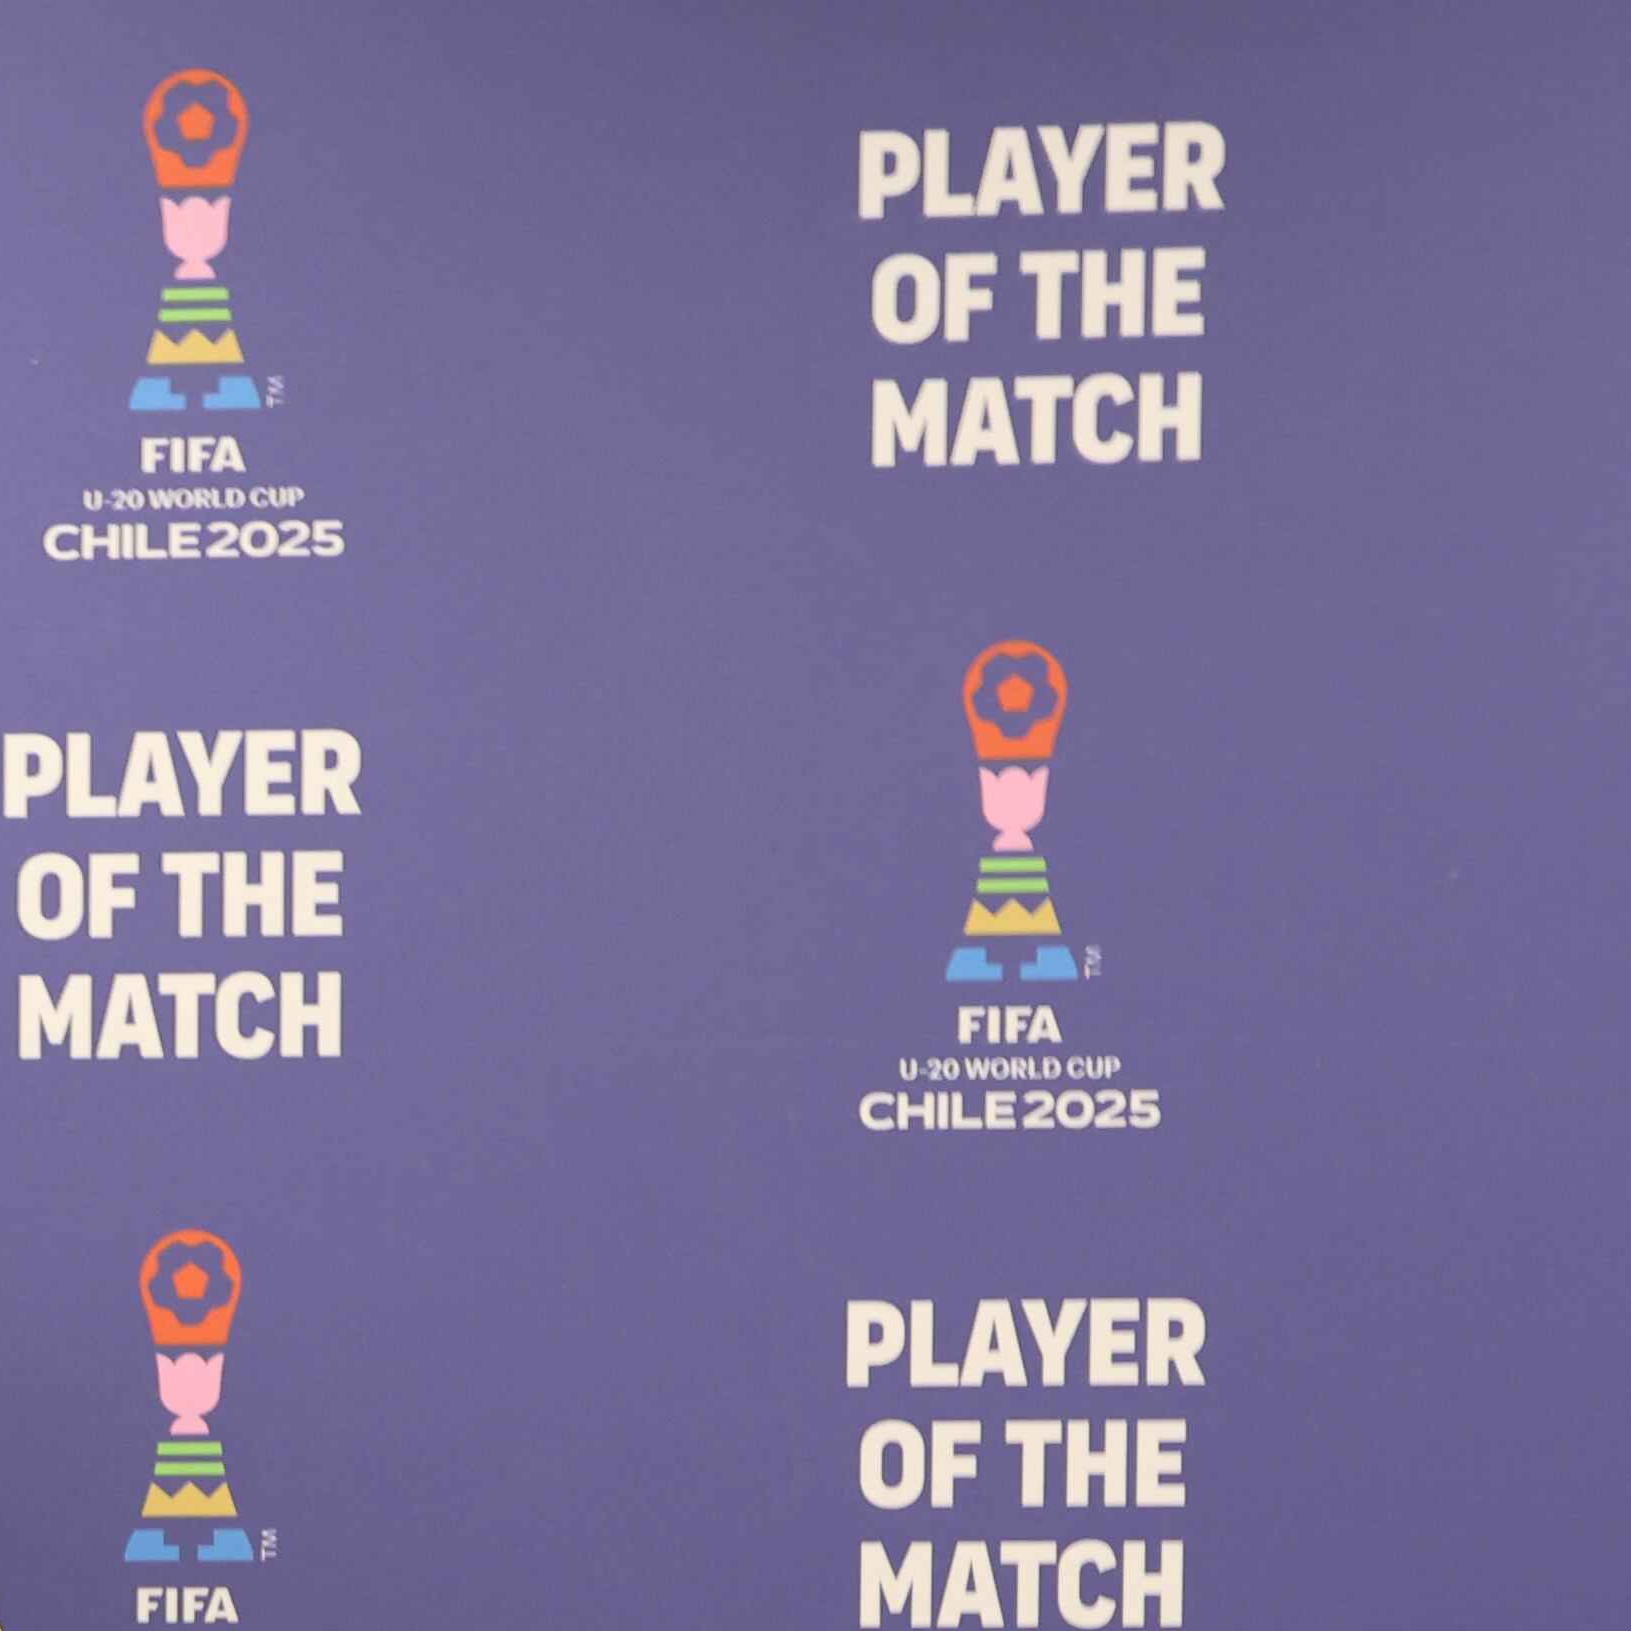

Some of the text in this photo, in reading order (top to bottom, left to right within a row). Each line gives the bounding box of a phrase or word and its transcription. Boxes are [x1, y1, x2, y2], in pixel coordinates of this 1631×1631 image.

[858, 121, 1226, 220] PLAYER
[871, 246, 1206, 345] OF THE
[141, 435, 246, 474] FIFA
[871, 371, 1203, 468] MATCH
[83, 486, 305, 511] U-20 WORLD CUP
[3, 728, 362, 819] PLAYER
[17, 850, 344, 941] OF THE
[19, 970, 342, 1060] MATCH
[957, 1005, 1063, 1044] FIFA
[899, 1056, 1122, 1081] U-20 WORLD CUP
[846, 1297, 1206, 1388] PLAYER
[859, 1418, 1187, 1510] OF THE
[136, 1586, 239, 1624] FIFA
[859, 1539, 1184, 1630] MATCH
